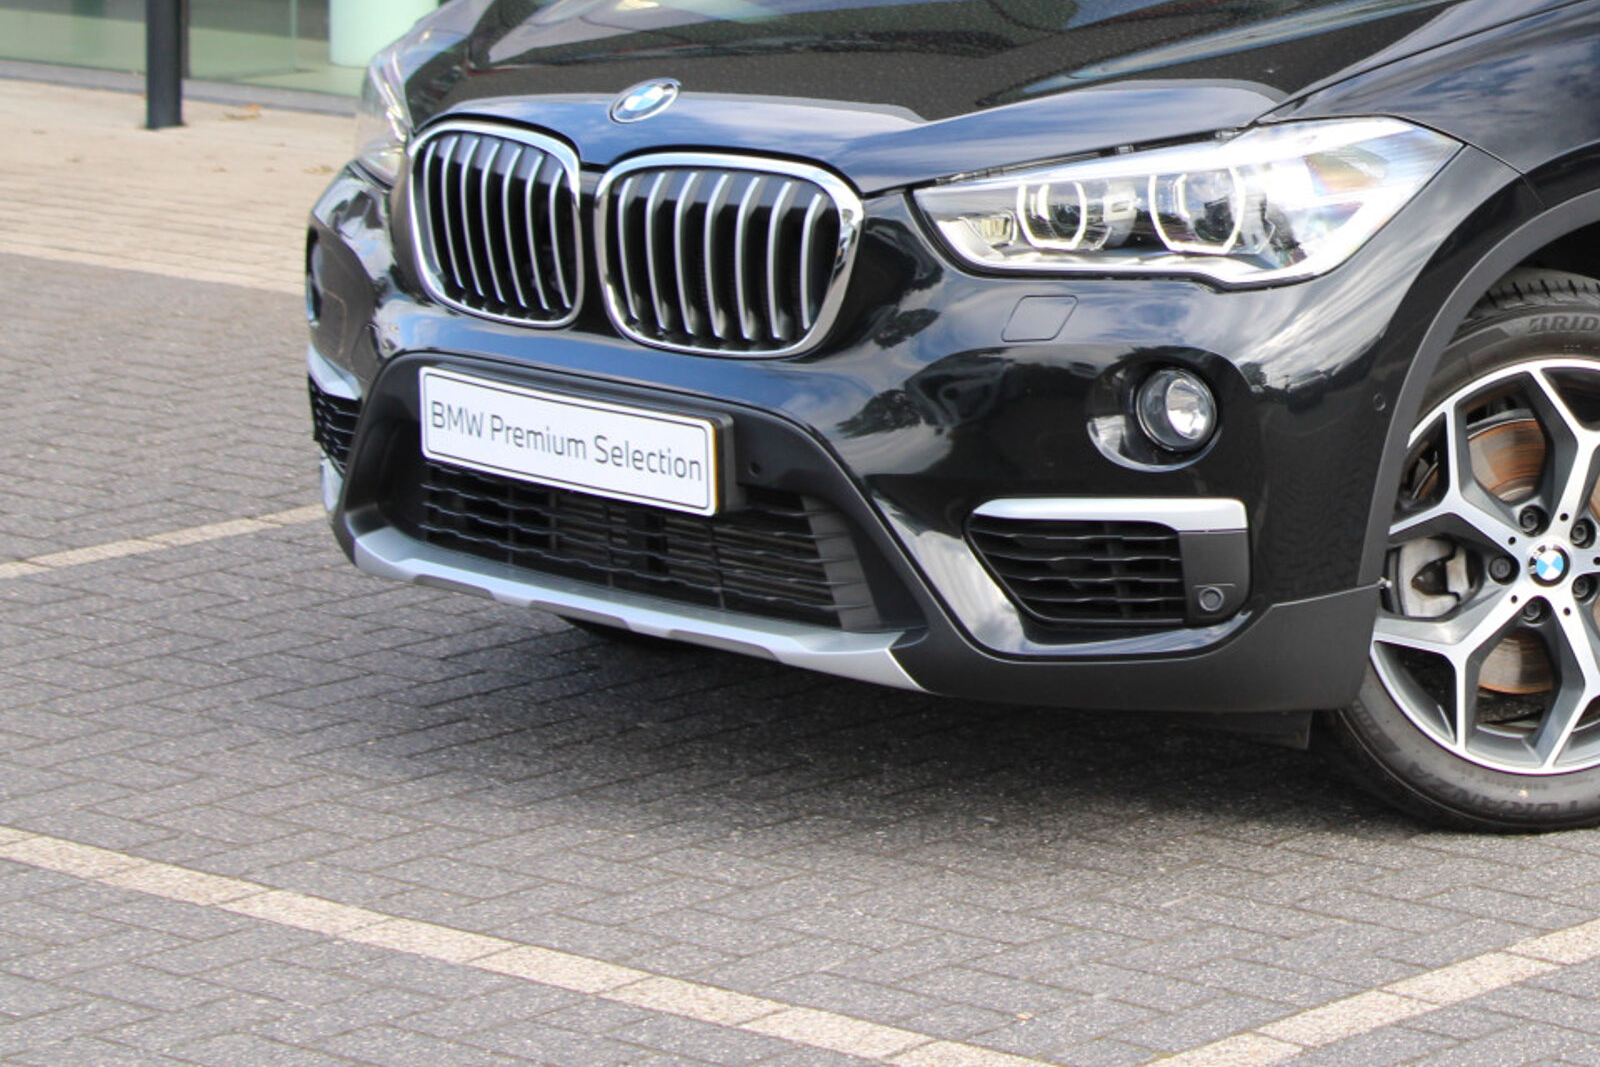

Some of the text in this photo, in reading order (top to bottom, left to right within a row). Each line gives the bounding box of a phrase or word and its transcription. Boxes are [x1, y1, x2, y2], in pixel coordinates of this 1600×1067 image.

[430, 400, 702, 481] BMW Premium Selection
